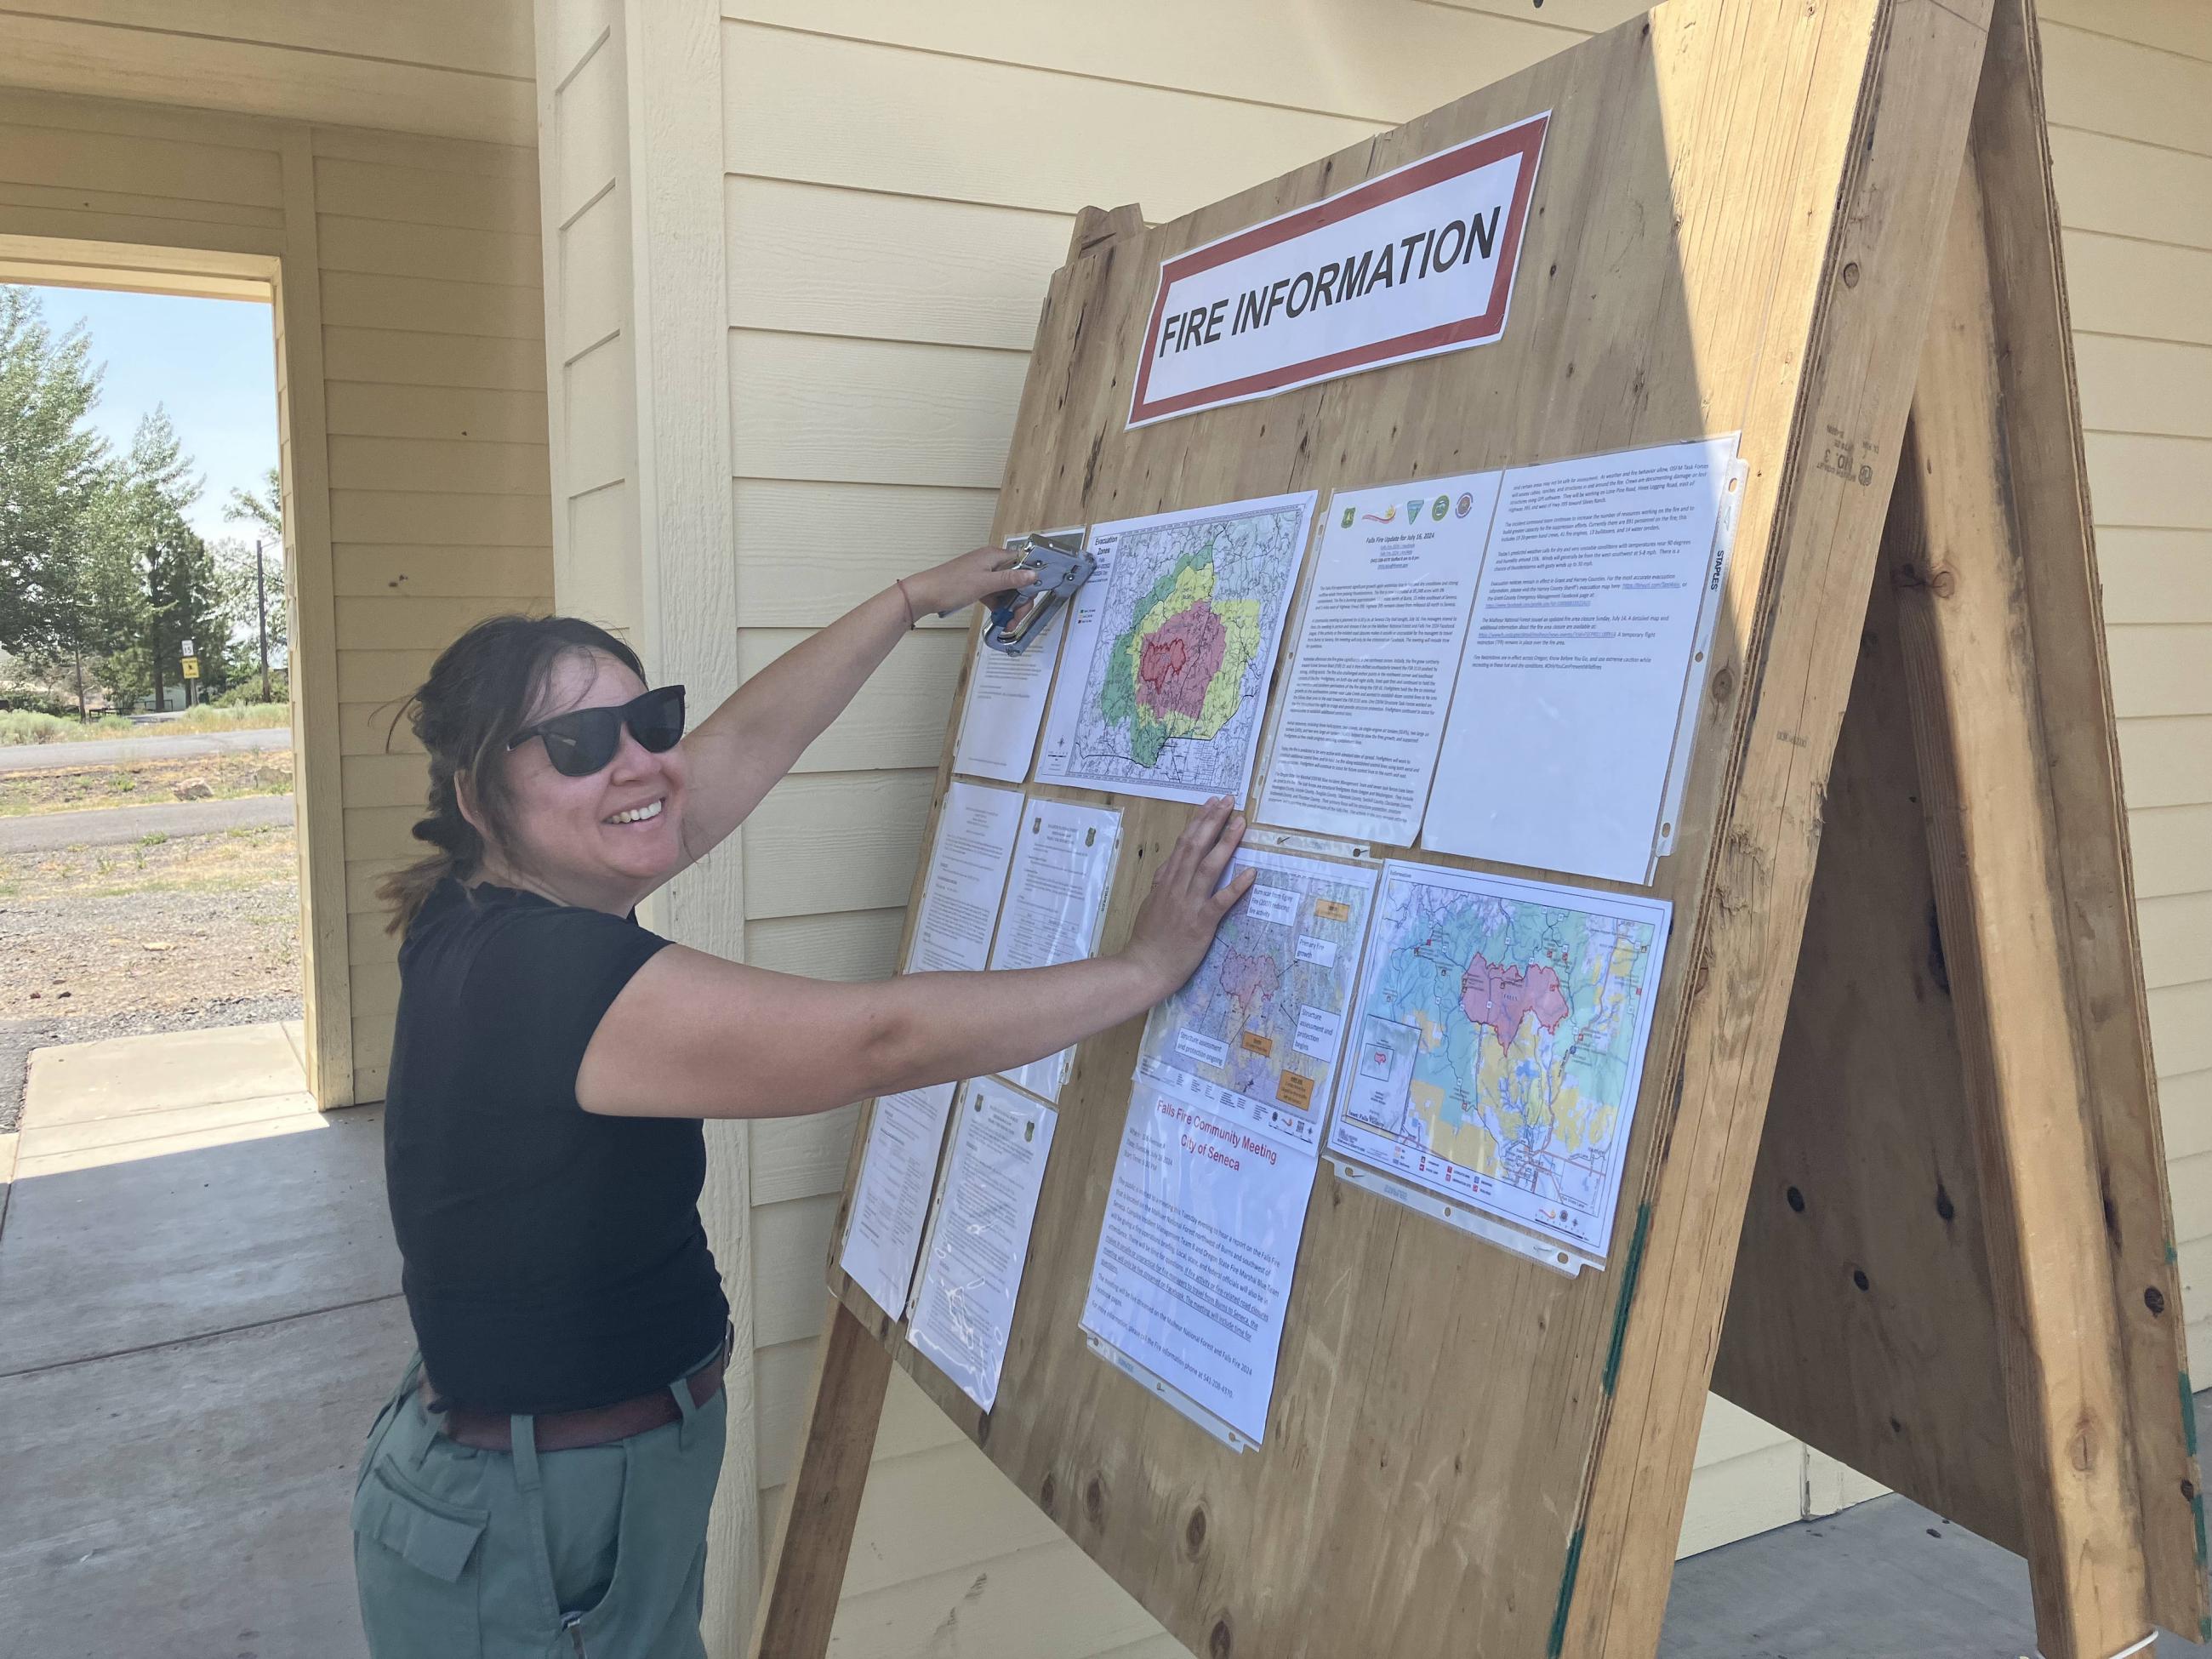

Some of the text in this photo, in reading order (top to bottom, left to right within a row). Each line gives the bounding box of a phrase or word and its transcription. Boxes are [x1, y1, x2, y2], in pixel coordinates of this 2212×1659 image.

[1159, 205, 1502, 358] FIRE INFORMATION
[1095, 536, 1118, 545] Evacuation
[1383, 534, 1400, 543] Update
[1406, 533, 1416, 541] July
[1710, 550, 1725, 590] STAPLES
[184, 646, 192, 654] 15
[1299, 939, 1316, 949] Primary
[1299, 1020, 1324, 1032] assessment
[1301, 1009, 1321, 1021] Structure
[1179, 1030, 1222, 1052] Structure assessment
[1294, 1040, 1308, 1050] begins
[1297, 1030, 1319, 1042] protection
[1183, 1046, 1206, 1059] protection
[1205, 1054, 1223, 1068] ongoing
[1156, 1099, 1176, 1117] Falls
[1176, 1108, 1193, 1125] Fire
[1193, 1115, 1240, 1149] Community
[1241, 1136, 1277, 1166] Meeting
[1180, 1134, 1197, 1154] City
[1197, 1143, 1207, 1155] of
[1207, 1146, 1240, 1171] Seneca
[1150, 1206, 1166, 1221] Malheur
[1166, 1215, 1183, 1229] National
[1182, 1223, 1195, 1236] Forest
[1220, 1244, 1234, 1257] Burns
[1233, 1252, 1242, 1262] and
[1241, 1257, 1265, 1274] southwest
[1181, 1209, 1197, 1225] Tuesday
[1197, 1219, 1213, 1234] evening
[1217, 1229, 1229, 1240] hear
[1232, 1238, 1246, 1249] report
[1246, 1245, 1252, 1253] on
[1252, 1247, 1261, 1257] the
[1260, 1251, 1271, 1263] Falls
[1270, 1257, 1280, 1267] Fire
[1155, 1223, 1181, 1242] Management
[1180, 1236, 1191, 1248] Team
[1194, 1246, 1203, 1254] and
[1203, 1249, 1218, 1263] Oregon
[1217, 1257, 1229, 1269] State
[1229, 1263, 1239, 1274] Fire
[1239, 1268, 1257, 1284] Marshal
[1257, 1278, 1267, 1290] Blue
[1266, 1284, 1279, 1297] Team
[1176, 1247, 1187, 1260] Local,
[1199, 1262, 1207, 1270] and
[1207, 1265, 1223, 1279] federal
[1222, 1274, 1239, 1288] officials
[1239, 1284, 1248, 1293] will
[1247, 1289, 1257, 1298] also
[1257, 1292, 1263, 1303] be
[1263, 1296, 1268, 1305] in
[1166, 1284, 1184, 1300] Facebook.
[1193, 1301, 1210, 1317] meeting
[1210, 1311, 1218, 1320] will
[1218, 1315, 1234, 1329] include
[1234, 1324, 1245, 1336] time
[1187, 1282, 1258, 1330] to travel from Burns to Seneca, the
[1195, 1274, 1210, 1288] activity
[1215, 1284, 1240, 1303] fire-related
[1240, 1299, 1251, 1309] road
[1251, 1305, 1268, 1320] closures
[1161, 1345, 1184, 1366] information
[1183, 1362, 1198, 1375] phone
[1166, 1315, 1183, 1331] Malheur
[1183, 1325, 1200, 1343] National
[1200, 1337, 1214, 1351] Forest
[1213, 1347, 1222, 1357] and
[1222, 1350, 1231, 1363] Falls
[1231, 1356, 1240, 1369] Fire
[1240, 1362, 1252, 1376] 2024
